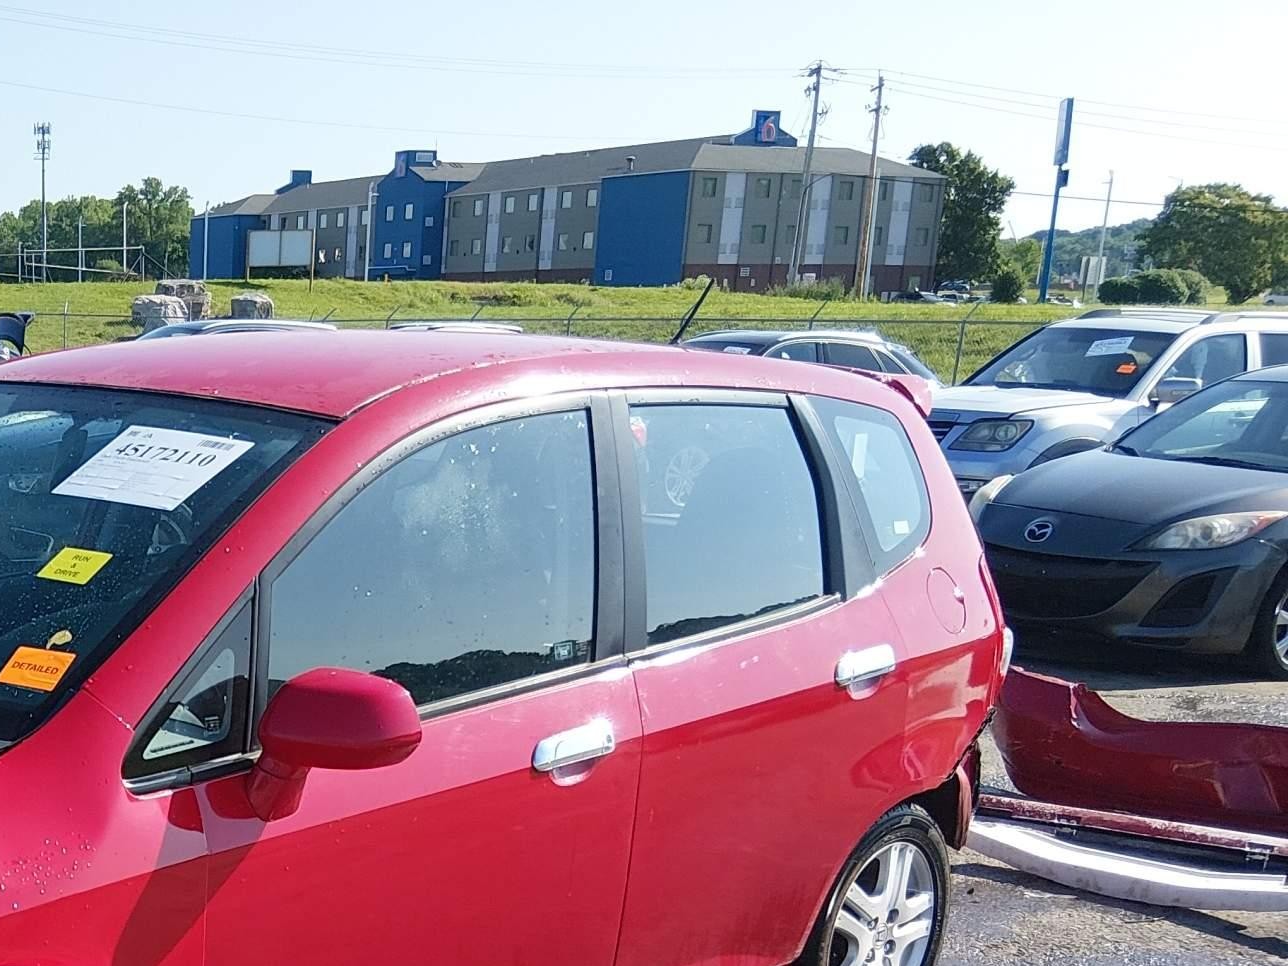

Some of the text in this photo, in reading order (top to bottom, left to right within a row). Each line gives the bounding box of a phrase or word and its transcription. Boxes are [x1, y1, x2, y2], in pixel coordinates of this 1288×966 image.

[761, 115, 776, 142] 6
[115, 442, 217, 467] 45172110
[72, 554, 92, 563] RUN
[54, 568, 81, 578] DRIVE
[11, 660, 59, 675] DETAILED
